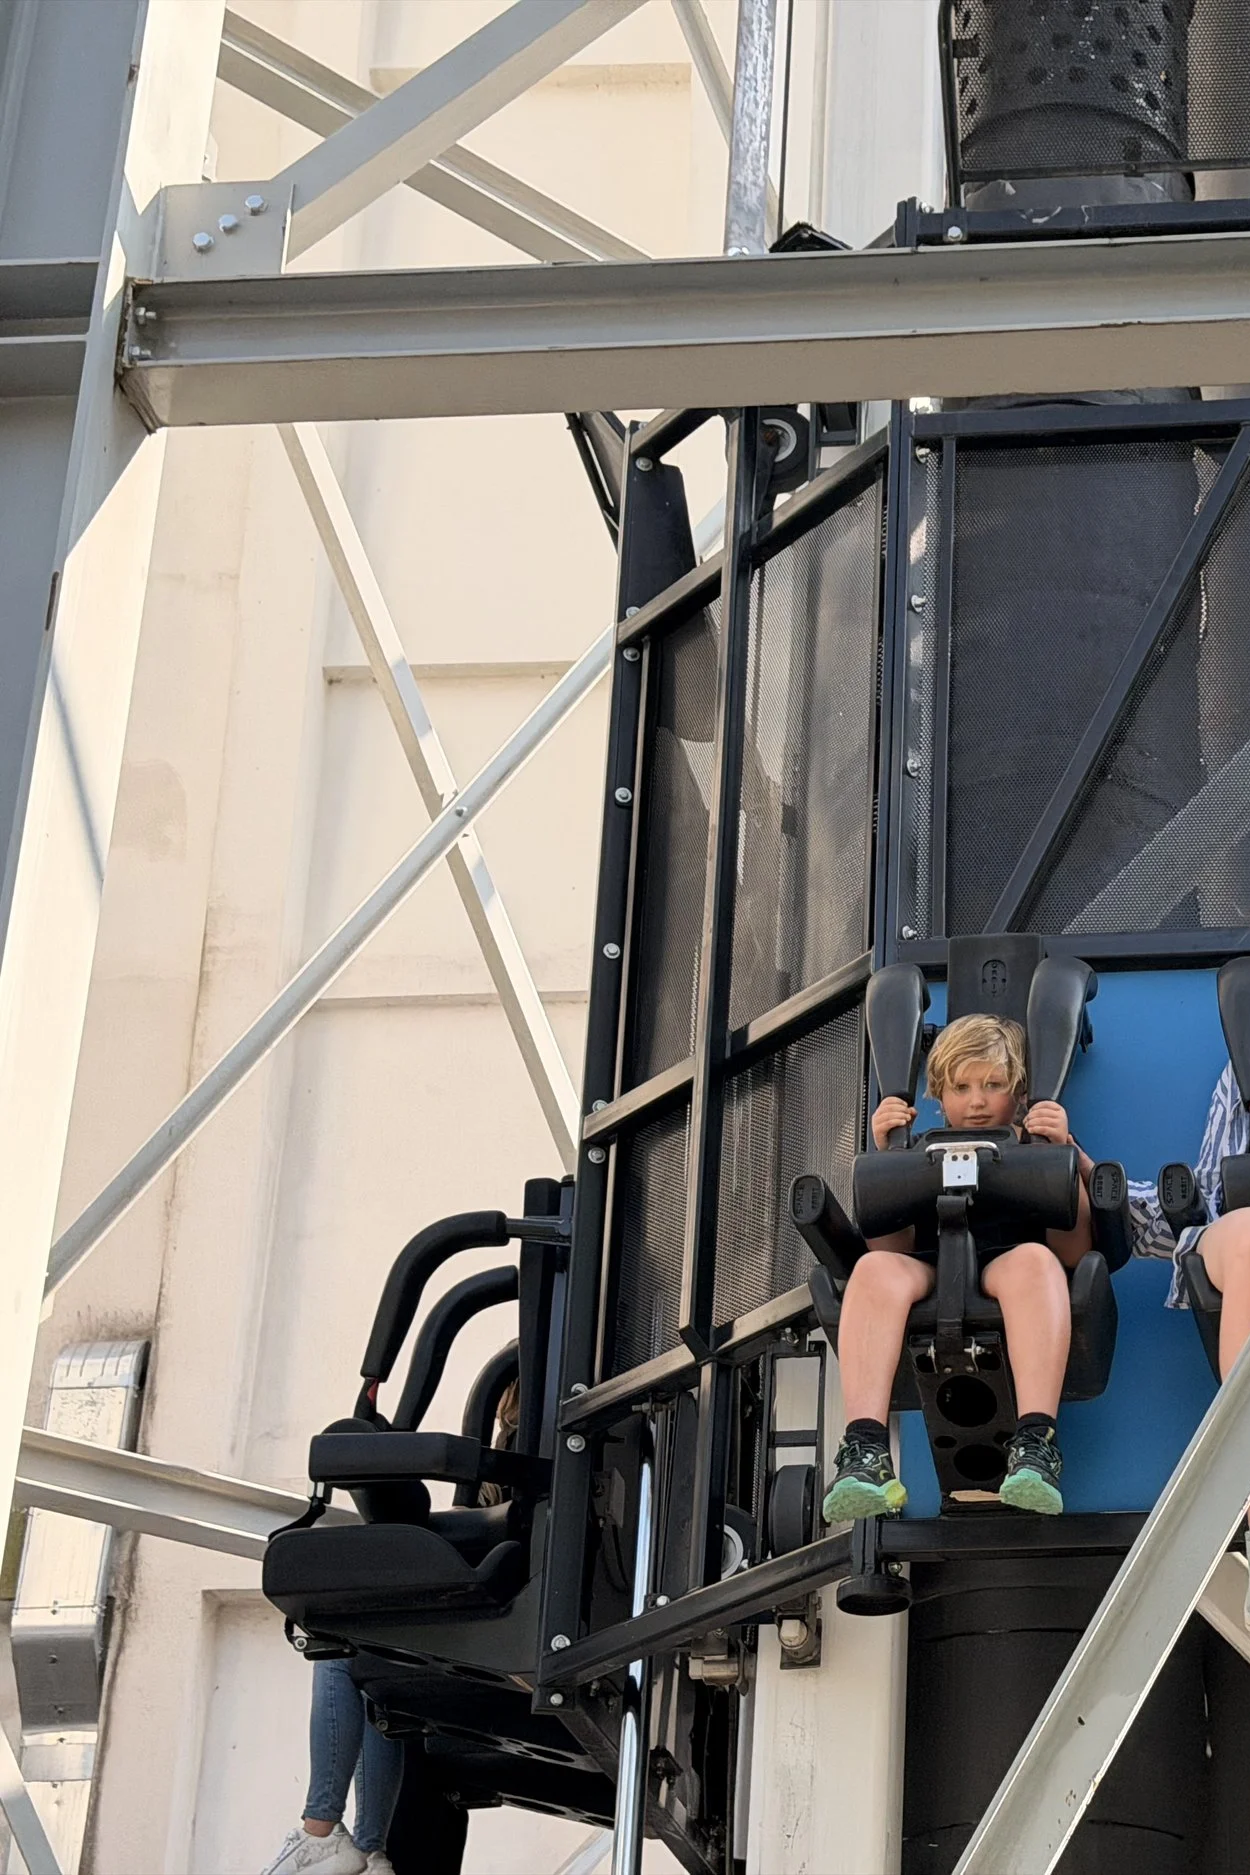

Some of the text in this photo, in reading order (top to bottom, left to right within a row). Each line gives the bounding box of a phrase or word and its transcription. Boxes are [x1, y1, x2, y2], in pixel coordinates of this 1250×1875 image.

[796, 1184, 805, 1214] SPACE
[1111, 1172, 1120, 1201] SPACE
[1166, 1176, 1174, 1204] SPACE
